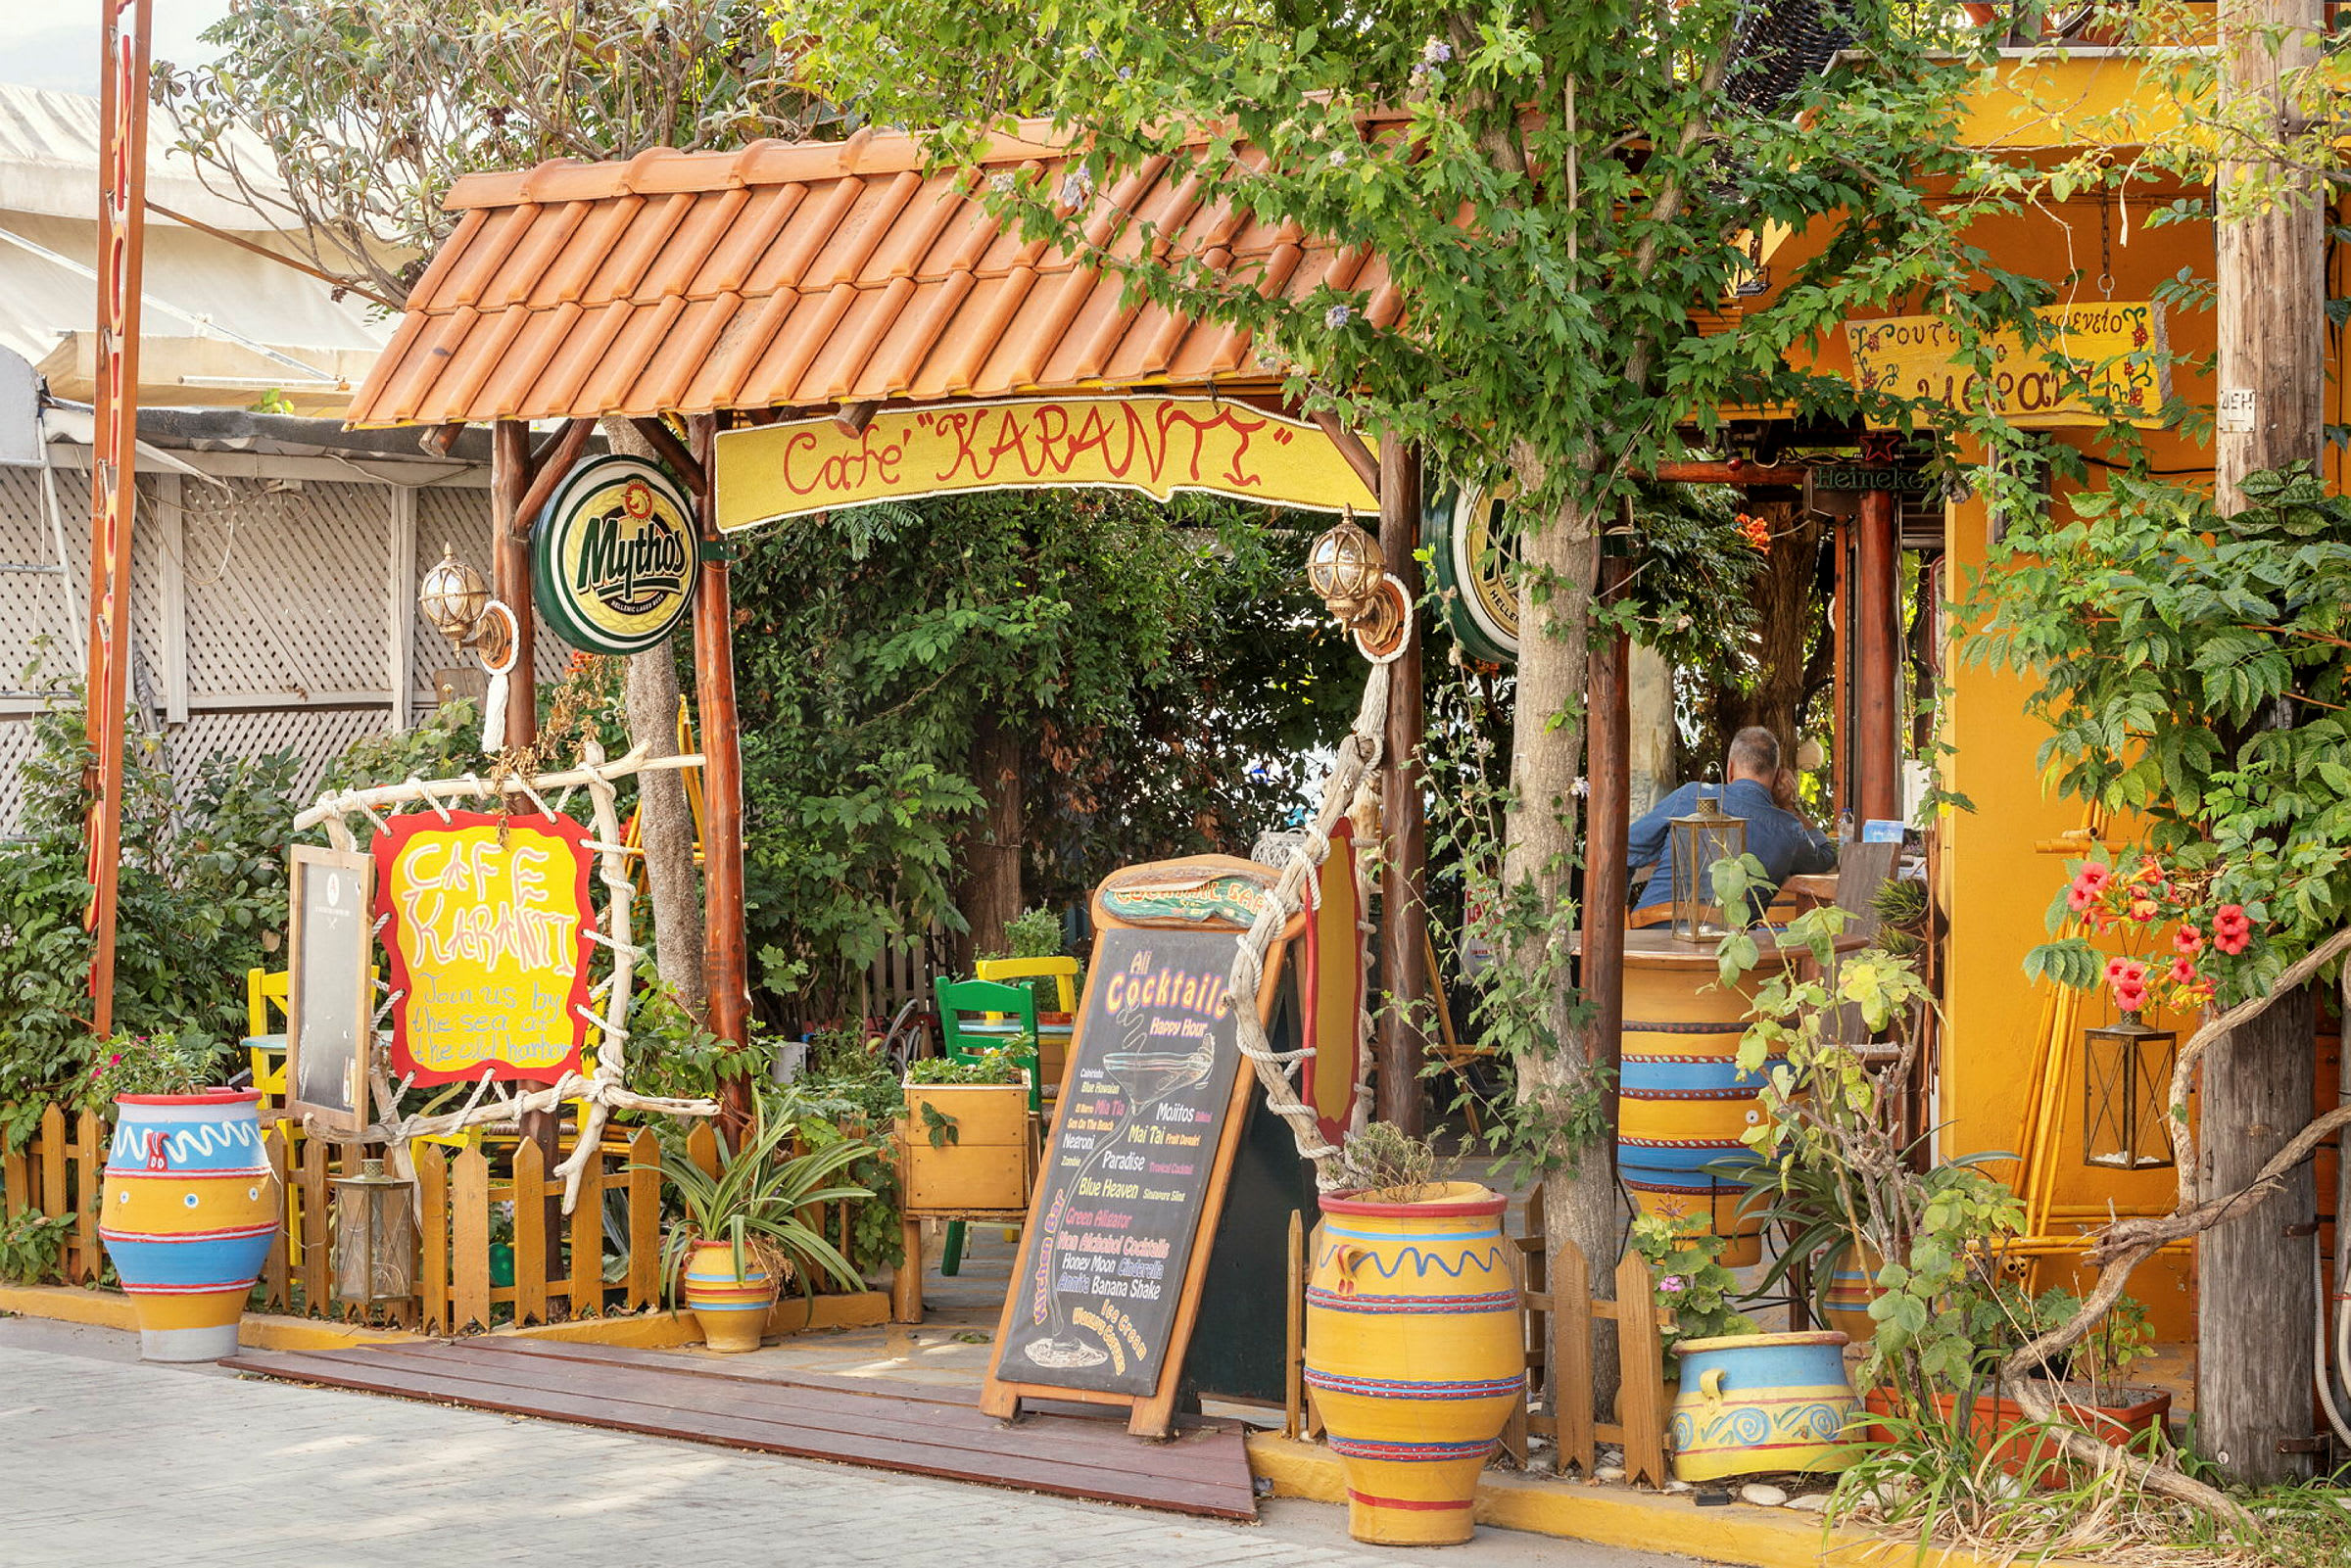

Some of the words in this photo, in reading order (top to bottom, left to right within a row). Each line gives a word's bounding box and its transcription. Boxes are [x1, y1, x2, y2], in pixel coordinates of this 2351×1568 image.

[1814, 466, 1940, 491] Heineke
[576, 516, 687, 601] Mythos
[403, 840, 550, 910] CAFE
[402, 889, 576, 977] KARANTI
[417, 972, 473, 1004] Join
[480, 986, 517, 1009] us
[533, 981, 561, 1022] by
[1106, 968, 1230, 1020] Cocktails
[412, 1006, 455, 1033] the
[459, 1014, 508, 1032] sea
[520, 1011, 549, 1031] at
[1150, 1016, 1182, 1038] Happy
[1181, 1018, 1209, 1038] Hour
[413, 1035, 455, 1065] the
[457, 1032, 497, 1062] old
[505, 1033, 574, 1063] harbor
[1080, 1080, 1095, 1094] Blue
[1155, 1102, 1195, 1123] Mojitos
[1128, 1123, 1148, 1144] Mai
[1148, 1124, 1167, 1145] Tai
[1101, 1150, 1146, 1172] Paradise
[1079, 1176, 1102, 1197] Blue
[1101, 1178, 1139, 1200] Heaven
[1065, 1206, 1094, 1226] Green
[1033, 1236, 1054, 1326] Kitchen
[1044, 1187, 1065, 1234] Bar
[1057, 1230, 1080, 1251] Non
[1123, 1236, 1171, 1259] Cocktails
[1061, 1252, 1091, 1271] Honey
[1090, 1255, 1117, 1274] Moon
[1090, 1275, 1128, 1298] Banana
[1129, 1278, 1162, 1301] Shake
[1101, 1298, 1121, 1324] Ice
[1118, 1313, 1148, 1362] Cream
